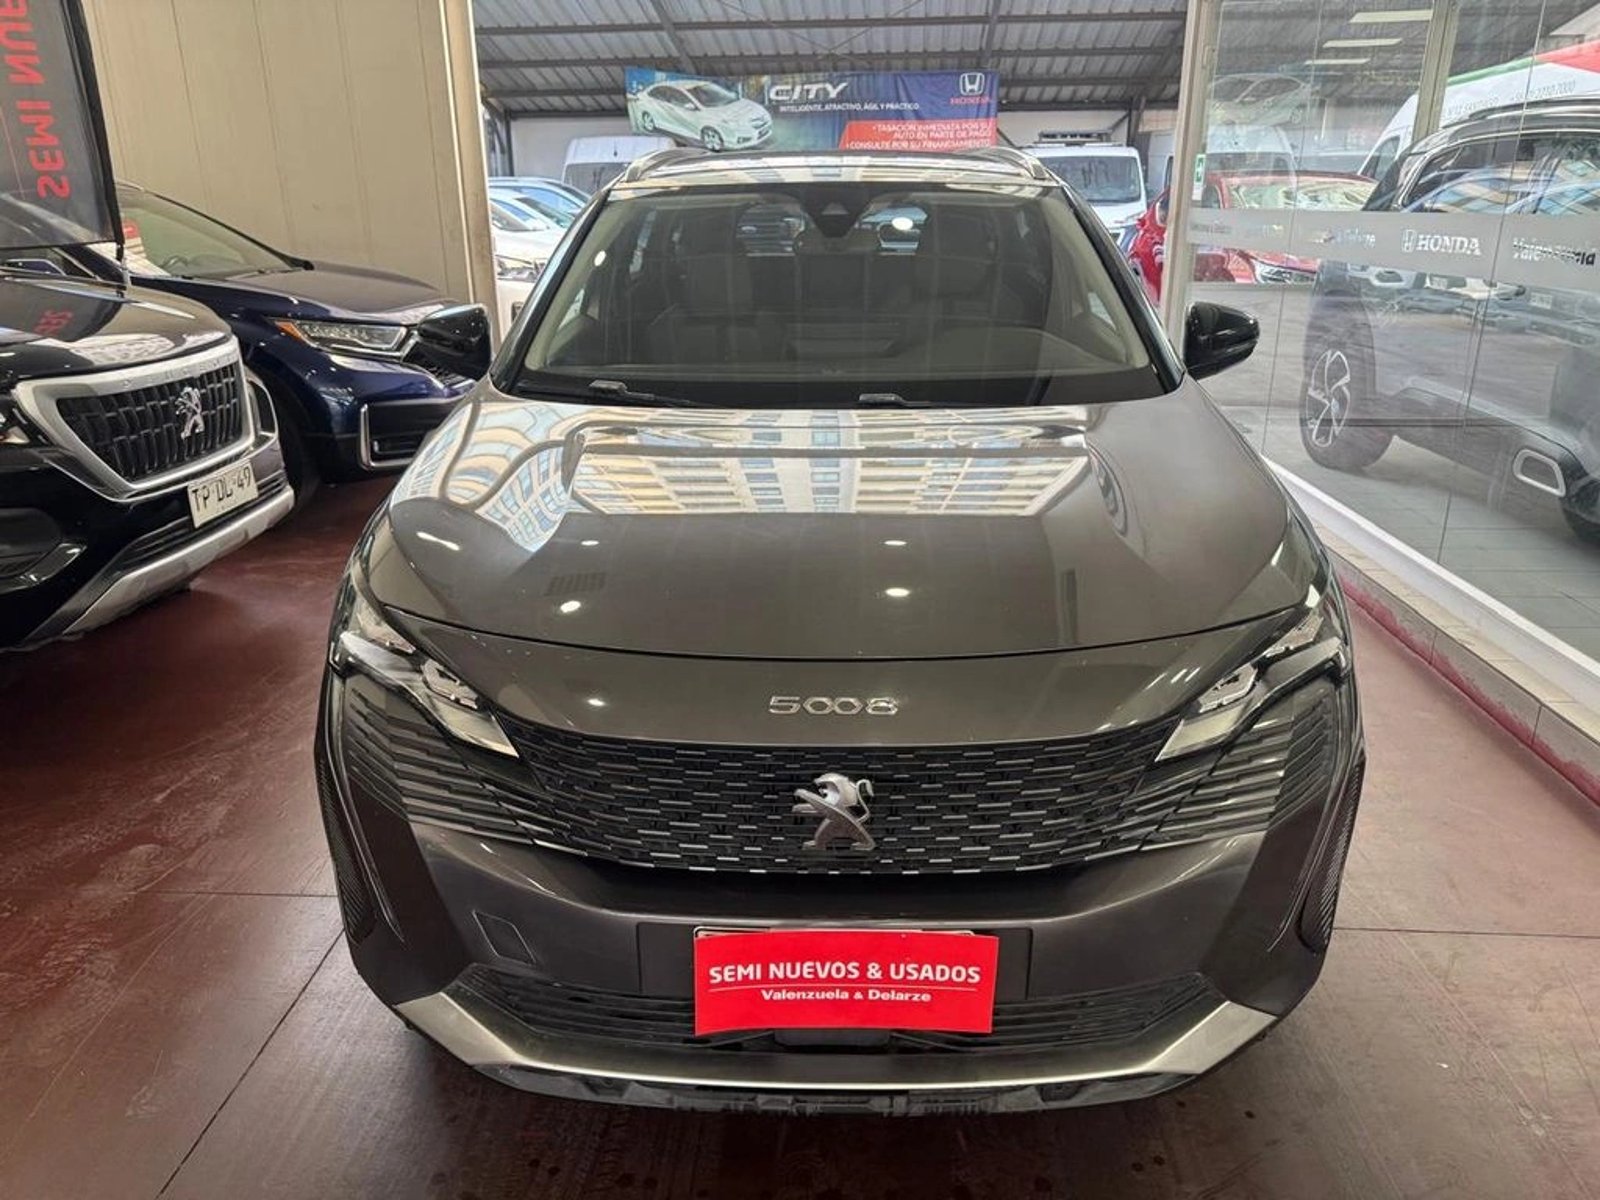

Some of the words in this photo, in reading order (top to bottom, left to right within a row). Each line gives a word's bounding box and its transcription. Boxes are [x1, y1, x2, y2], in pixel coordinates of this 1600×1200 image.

[770, 82, 848, 100] CITY
[1417, 234, 1482, 255] HONDA
[768, 695, 899, 716] 5008
[709, 962, 762, 984] SEMI
[768, 961, 860, 981] NUEVOS
[866, 963, 883, 979] &
[889, 963, 981, 984] USADOS
[762, 988, 849, 1001] Valenzuela
[853, 991, 864, 1000] &
[868, 989, 932, 1003] Delarze
